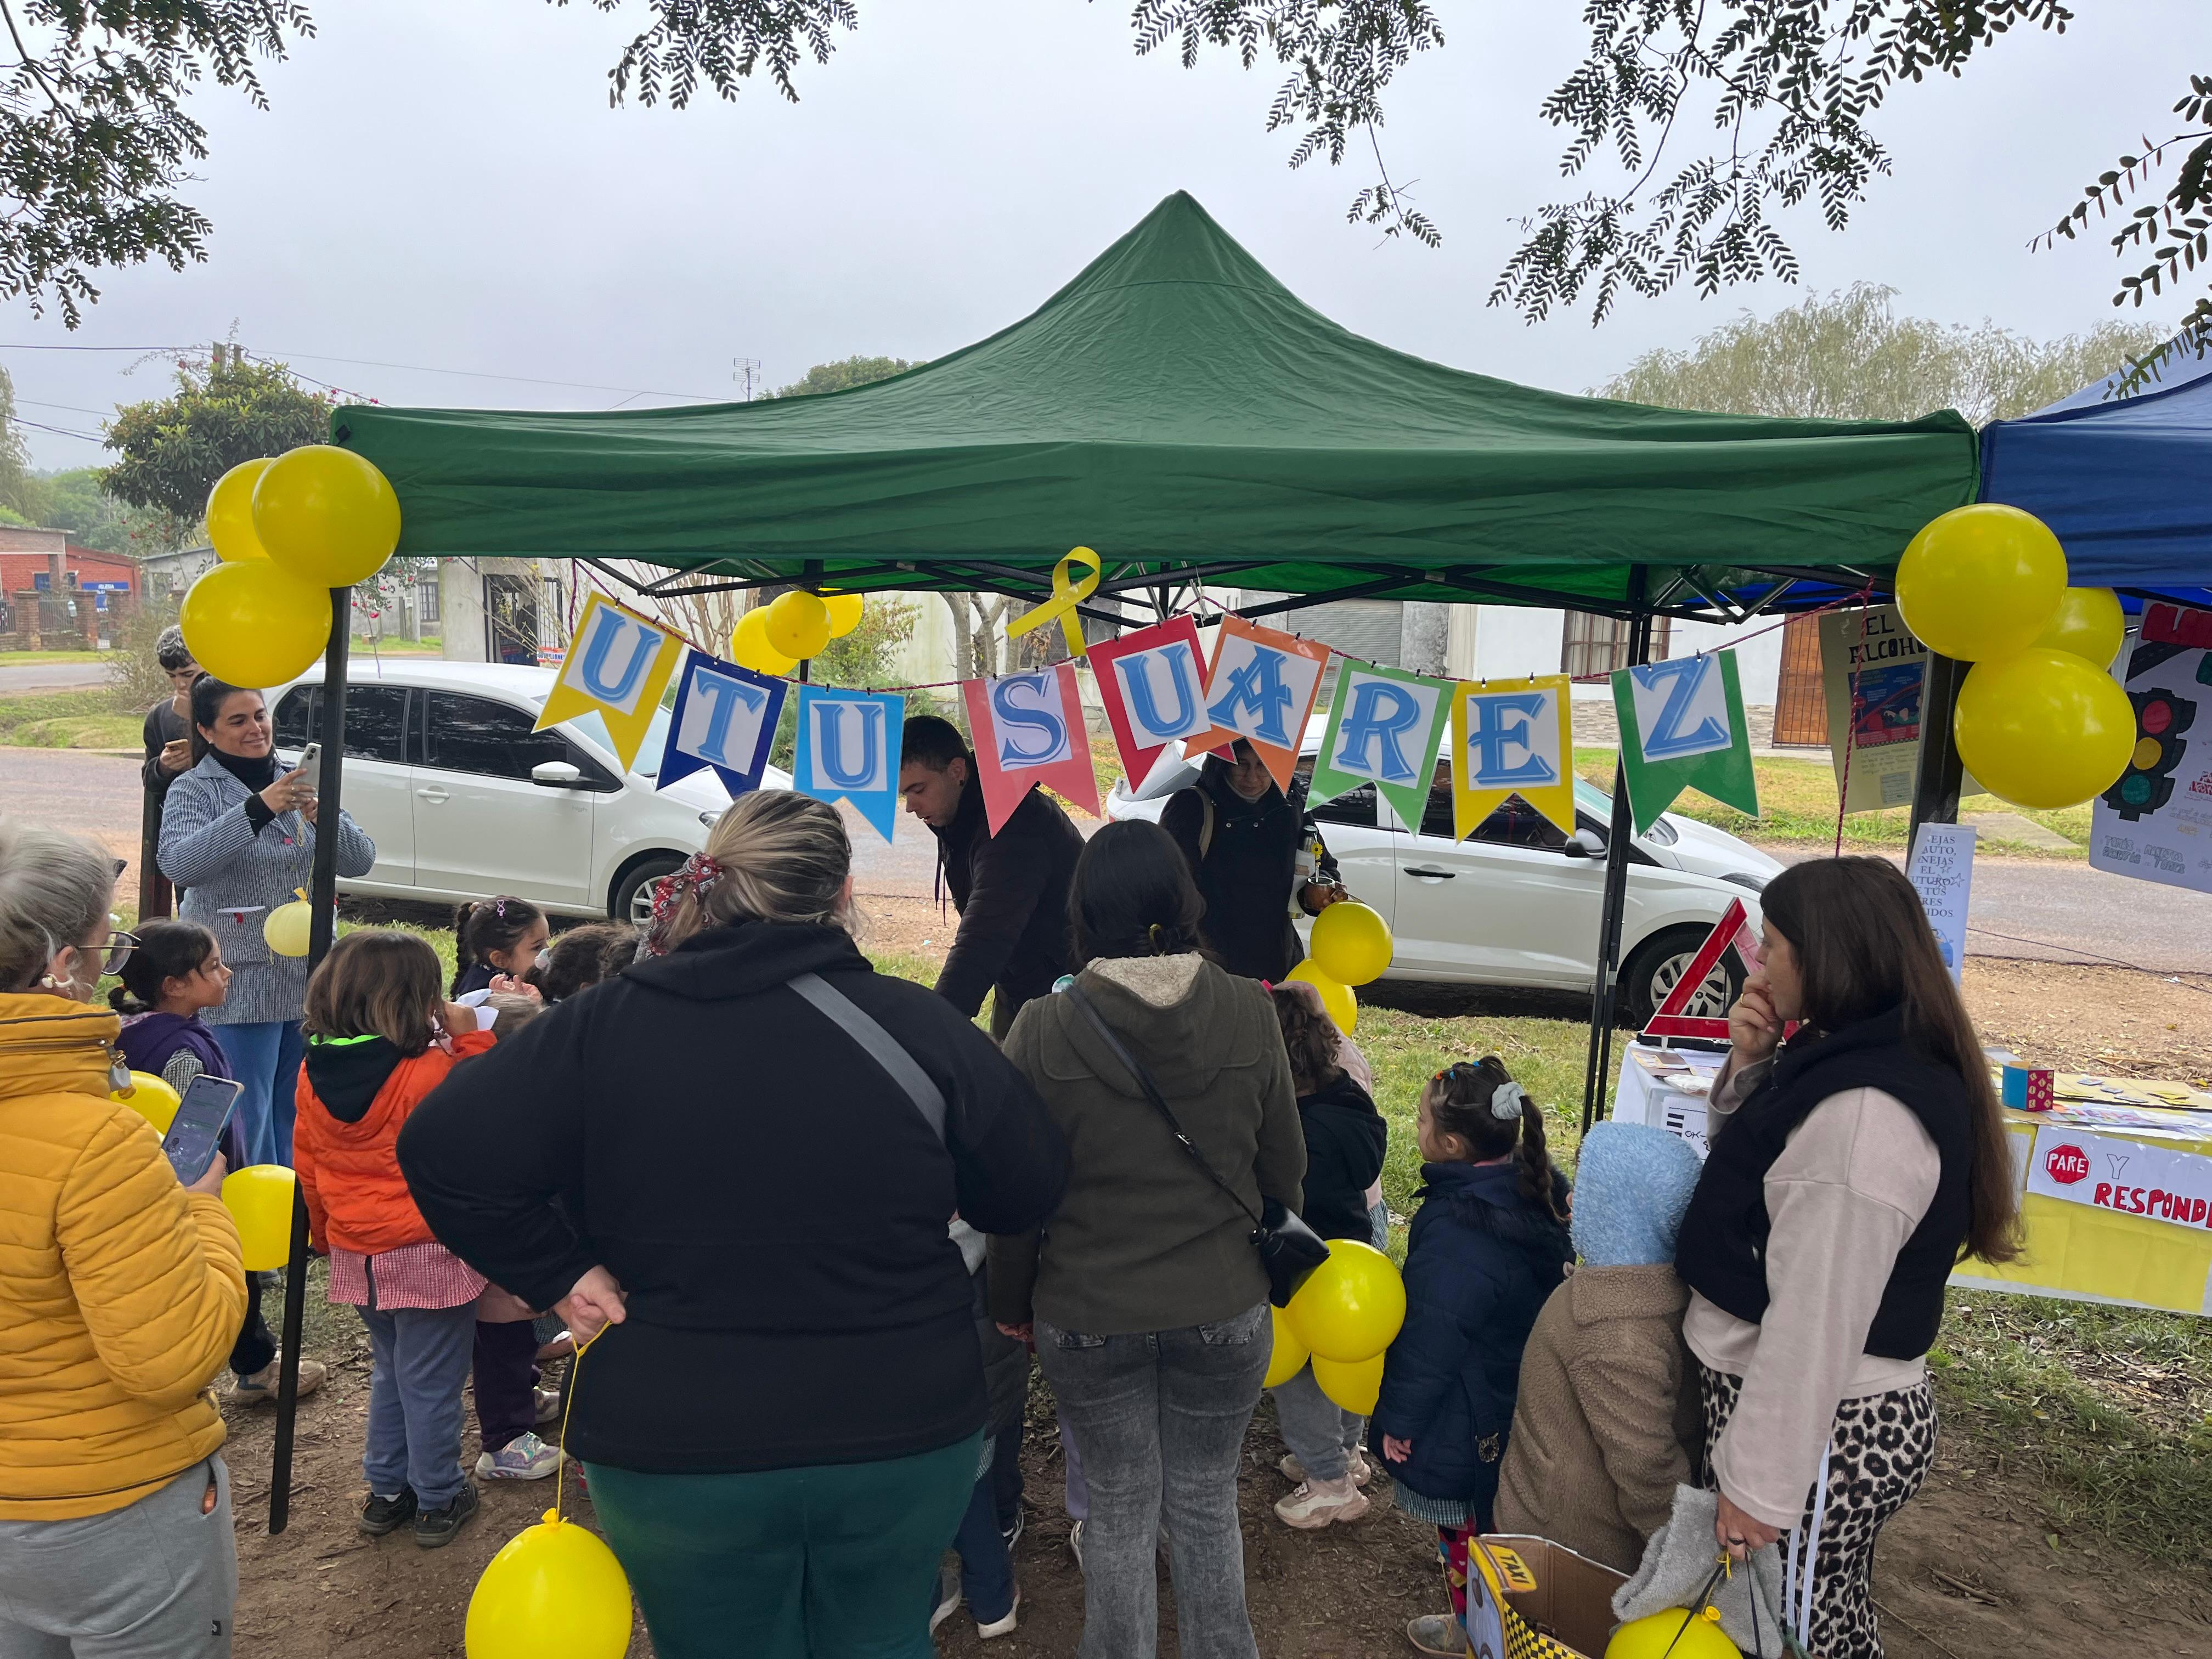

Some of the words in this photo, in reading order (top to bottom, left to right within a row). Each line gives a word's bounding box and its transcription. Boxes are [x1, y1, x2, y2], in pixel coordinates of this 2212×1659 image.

[1866, 614, 1895, 635] EL
[1927, 835, 1956, 845] EJAS
[1921, 866, 1936, 874] EL
[1911, 876, 1951, 886] UTURO
[1924, 887, 1947, 896] TUS
[1922, 897, 1943, 906] RES
[2048, 1153, 2087, 1173] PARE
[2106, 1153, 2130, 1180] Y
[1499, 1555, 1531, 1584] TAXI
